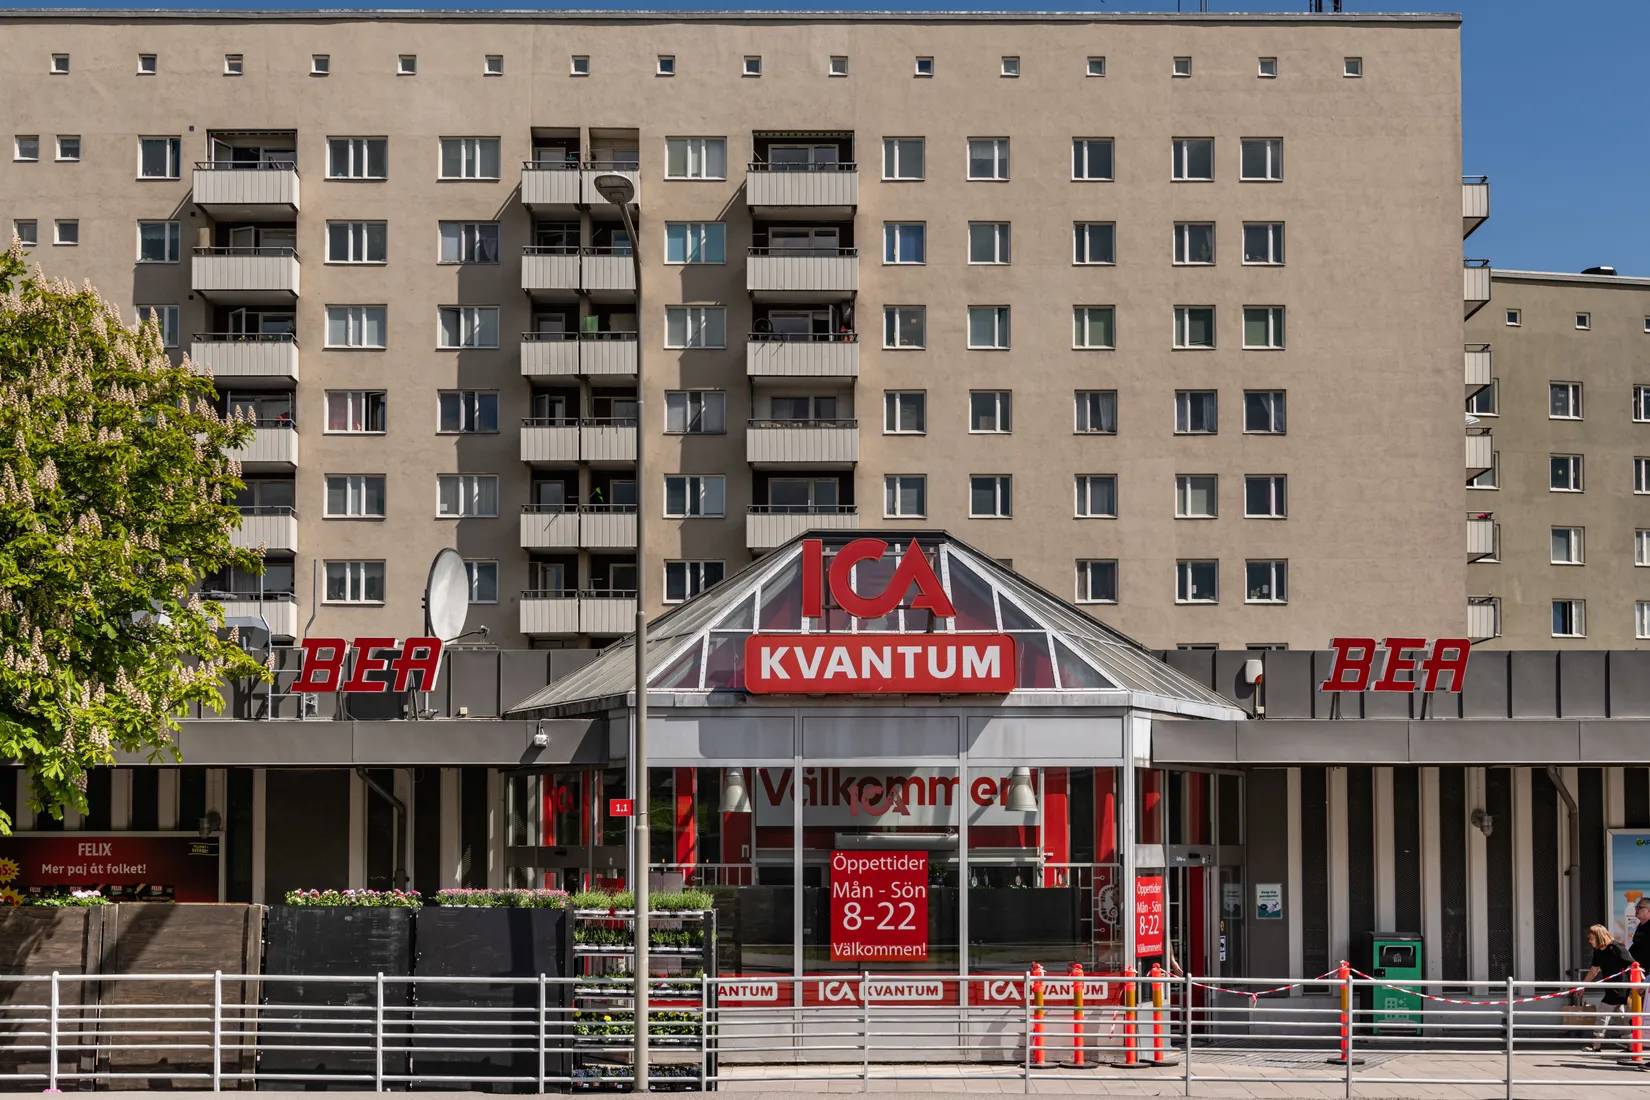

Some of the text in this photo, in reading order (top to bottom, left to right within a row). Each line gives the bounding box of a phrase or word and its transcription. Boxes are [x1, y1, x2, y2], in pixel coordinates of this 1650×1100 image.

[802, 537, 958, 619] ICA
[290, 637, 444, 693] BEA
[760, 645, 1001, 680] KVANTUM
[1319, 637, 1472, 693] BEA
[78, 842, 112, 857] FELIX
[41, 862, 147, 877] Mer paj åt folket!
[833, 852, 926, 874] Öppettider
[833, 880, 874, 899] Mån
[891, 881, 926, 899] Sön
[1136, 881, 1162, 897] Öppettider
[842, 901, 917, 931] 8-22
[1136, 900, 1149, 914] Mån
[1151, 900, 1162, 913] Sön
[1139, 914, 1160, 936] 8-22
[833, 941, 926, 957] Välkommen!
[1136, 942, 1163, 954] Välkommen!
[718, 985, 774, 997] ANTUM
[818, 981, 939, 1002] ICA KVANTUM
[984, 981, 1022, 1001] ICA
